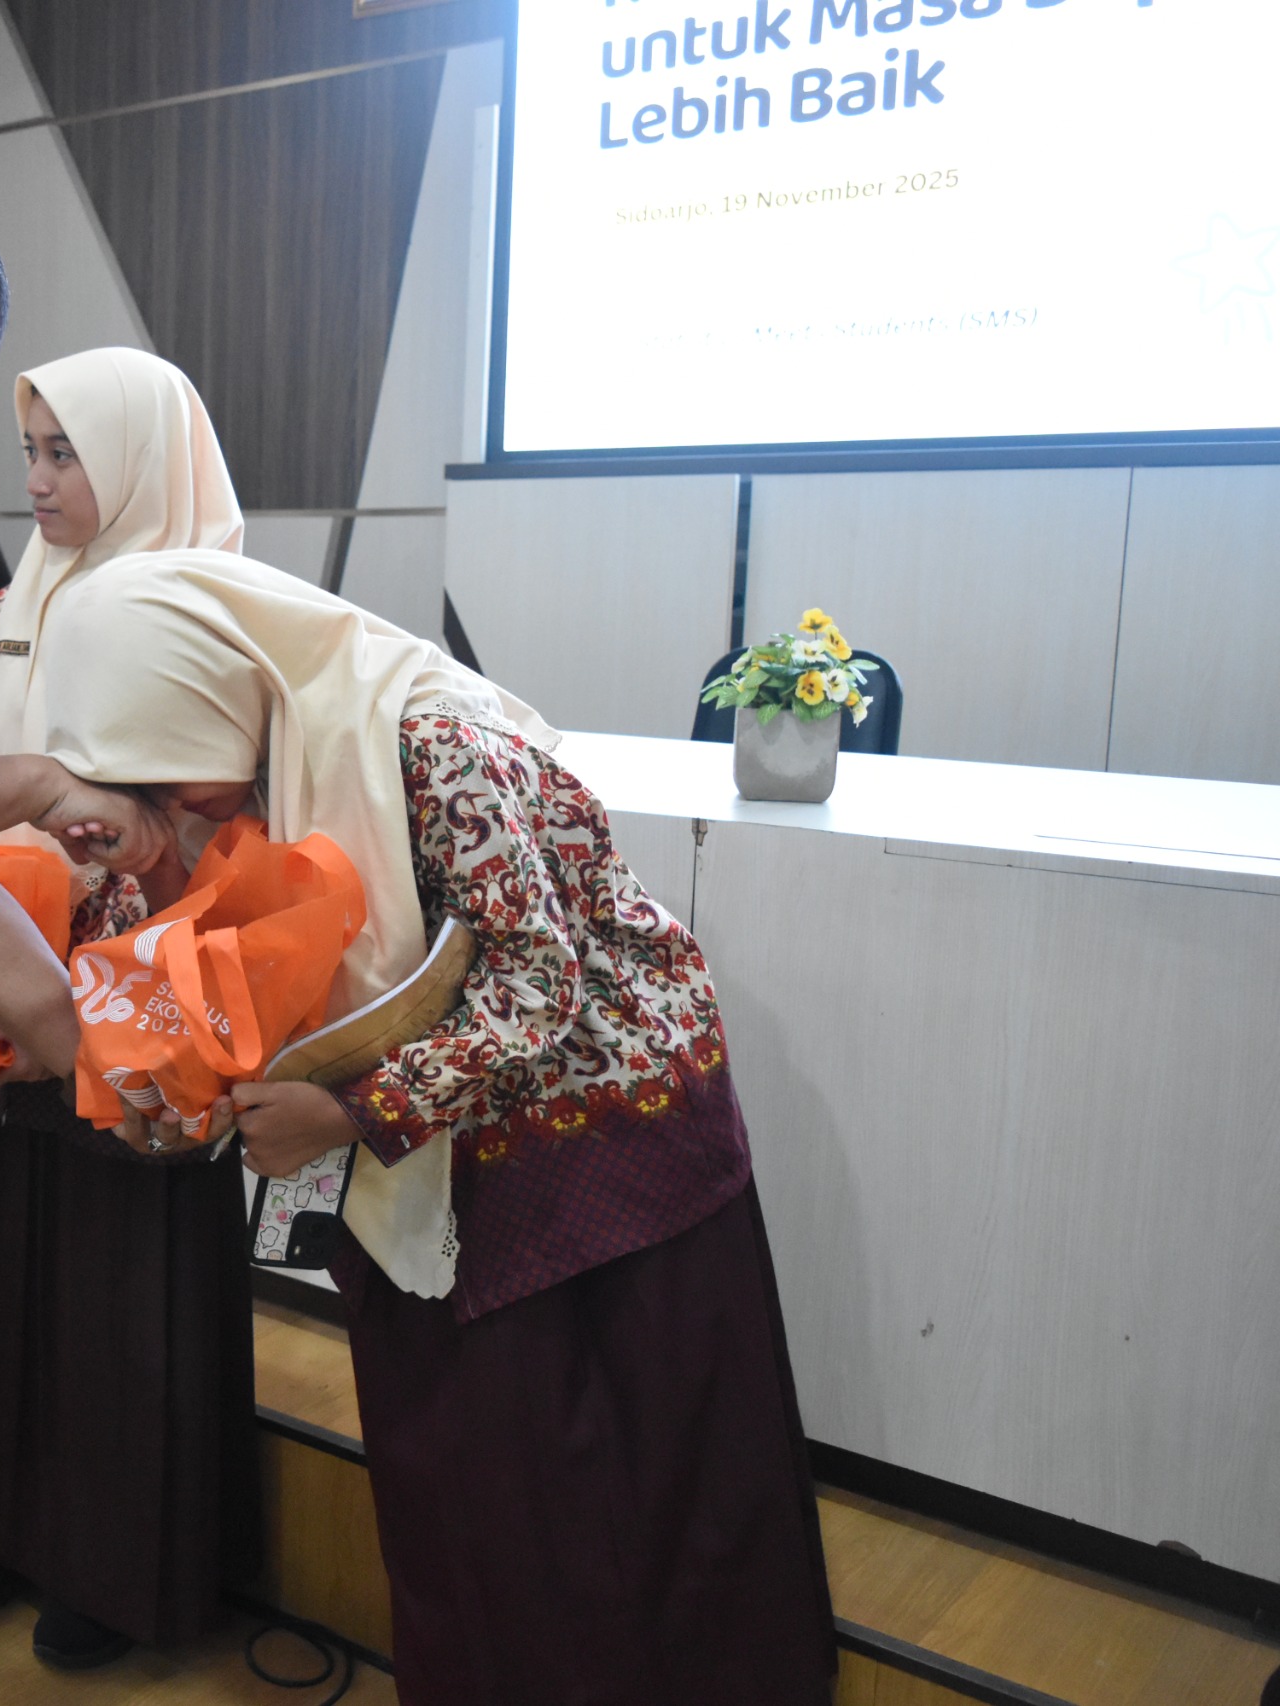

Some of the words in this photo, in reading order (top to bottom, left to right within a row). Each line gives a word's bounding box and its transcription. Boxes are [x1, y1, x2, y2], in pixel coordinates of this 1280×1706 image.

[602, 0, 791, 78] untuk
[600, 75, 770, 149] Lebih
[790, 48, 945, 123] Baik
[723, 193, 747, 214] 19
[757, 181, 886, 208] November
[895, 168, 960, 194] 2025
[960, 307, 1038, 332] (SMS)
